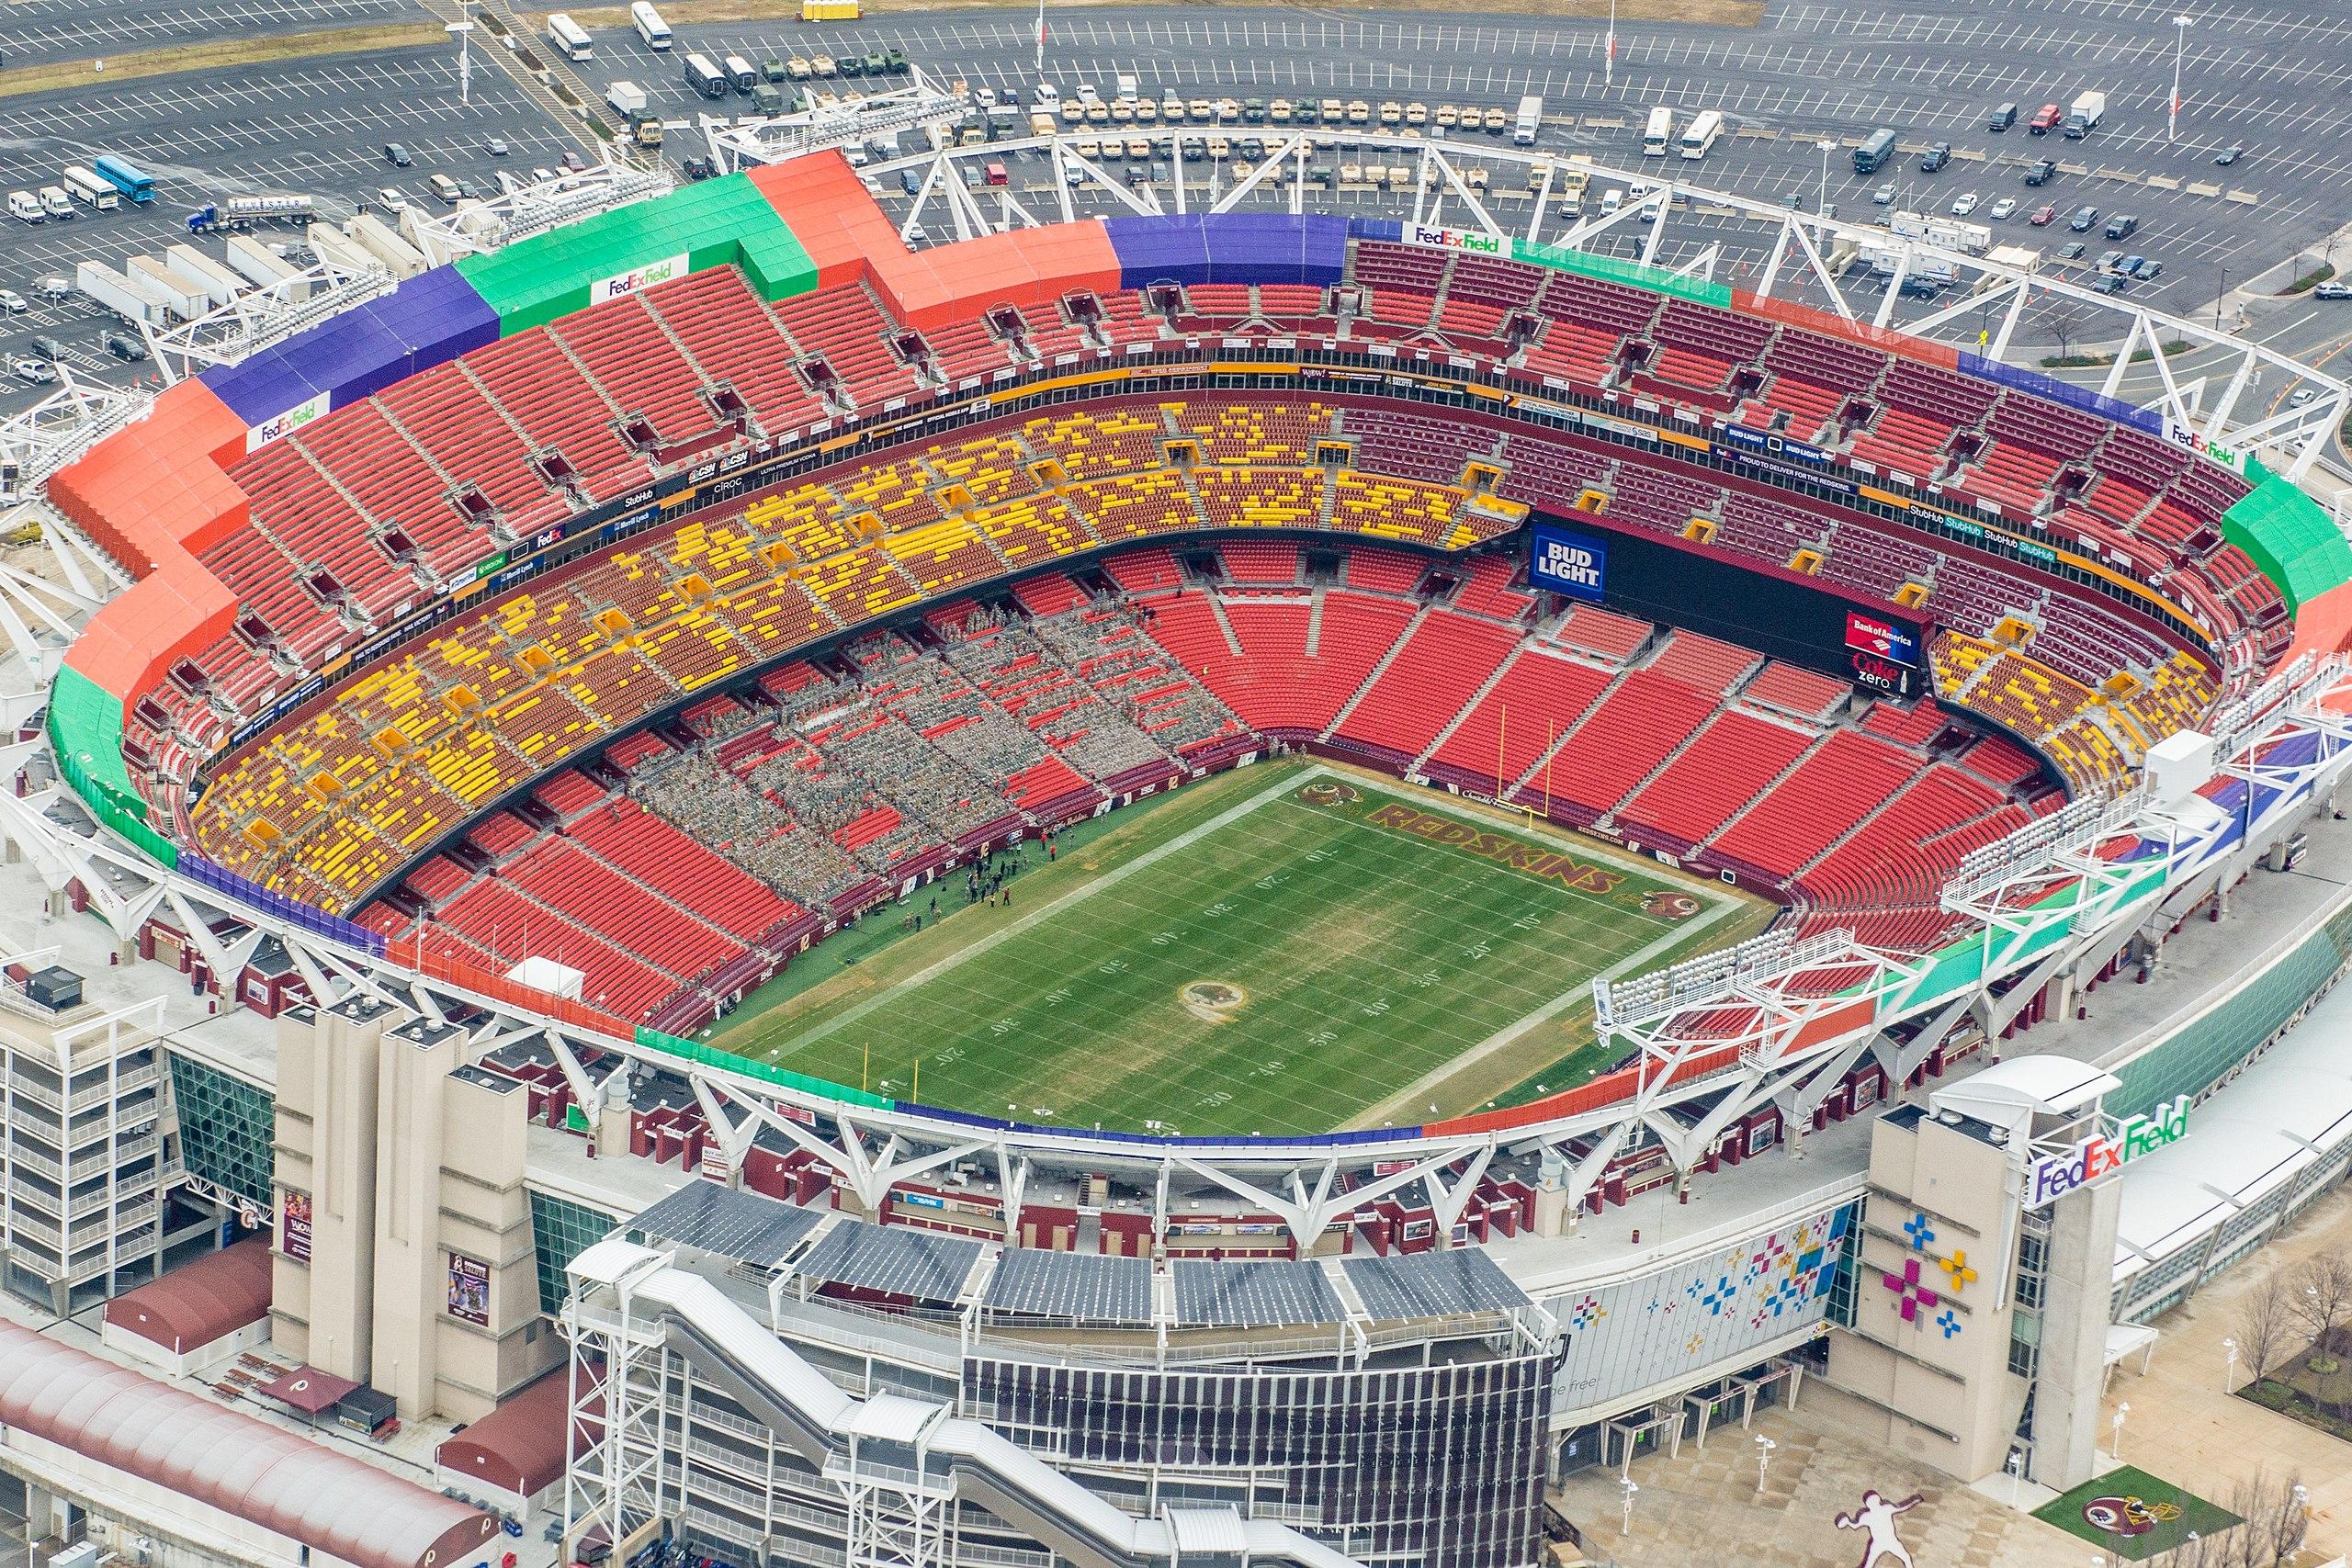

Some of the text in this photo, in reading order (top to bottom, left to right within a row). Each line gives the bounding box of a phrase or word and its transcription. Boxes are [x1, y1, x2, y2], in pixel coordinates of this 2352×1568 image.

[1415, 227, 1499, 253] FedExField
[609, 262, 672, 296] FedExField
[262, 402, 315, 442] FedExField
[1729, 429, 1764, 444] BUD LIGHT
[2172, 424, 2234, 466] FedExField
[730, 451, 748, 464] CSN
[1786, 445, 1821, 460] BUD LIGHT
[698, 462, 716, 476] CSN
[761, 466, 776, 475] ULTRA
[1739, 455, 1760, 467] PROUD
[1770, 464, 1794, 476] DELIVER
[1794, 470, 1806, 479] FOR
[1806, 473, 1819, 483] THE
[625, 490, 653, 507] StubHub
[1909, 505, 1944, 525] StubHub
[1945, 517, 1981, 536] StubHub
[537, 528, 563, 548] FedEx
[1984, 530, 2018, 548] StubHub
[1548, 542, 1592, 568] BUD
[2019, 541, 2054, 561] StubHub
[1538, 556, 1600, 586] LIGHT
[1854, 620, 1912, 647] Bank of America
[1852, 652, 1899, 682] Coke
[1858, 671, 1890, 688] zero
[1577, 826, 1623, 845] REDSKINS.COM
[1365, 804, 1626, 894] REDSKINS
[1513, 916, 1541, 930] 10
[1463, 943, 1491, 960] 20
[1363, 1001, 1390, 1017] 40
[1308, 1032, 1339, 1046] 50
[1258, 1061, 1285, 1076] 40
[1202, 1091, 1233, 1107] 30
[2033, 1096, 2191, 1203] FedExField
[1570, 1378, 1597, 1392] free
